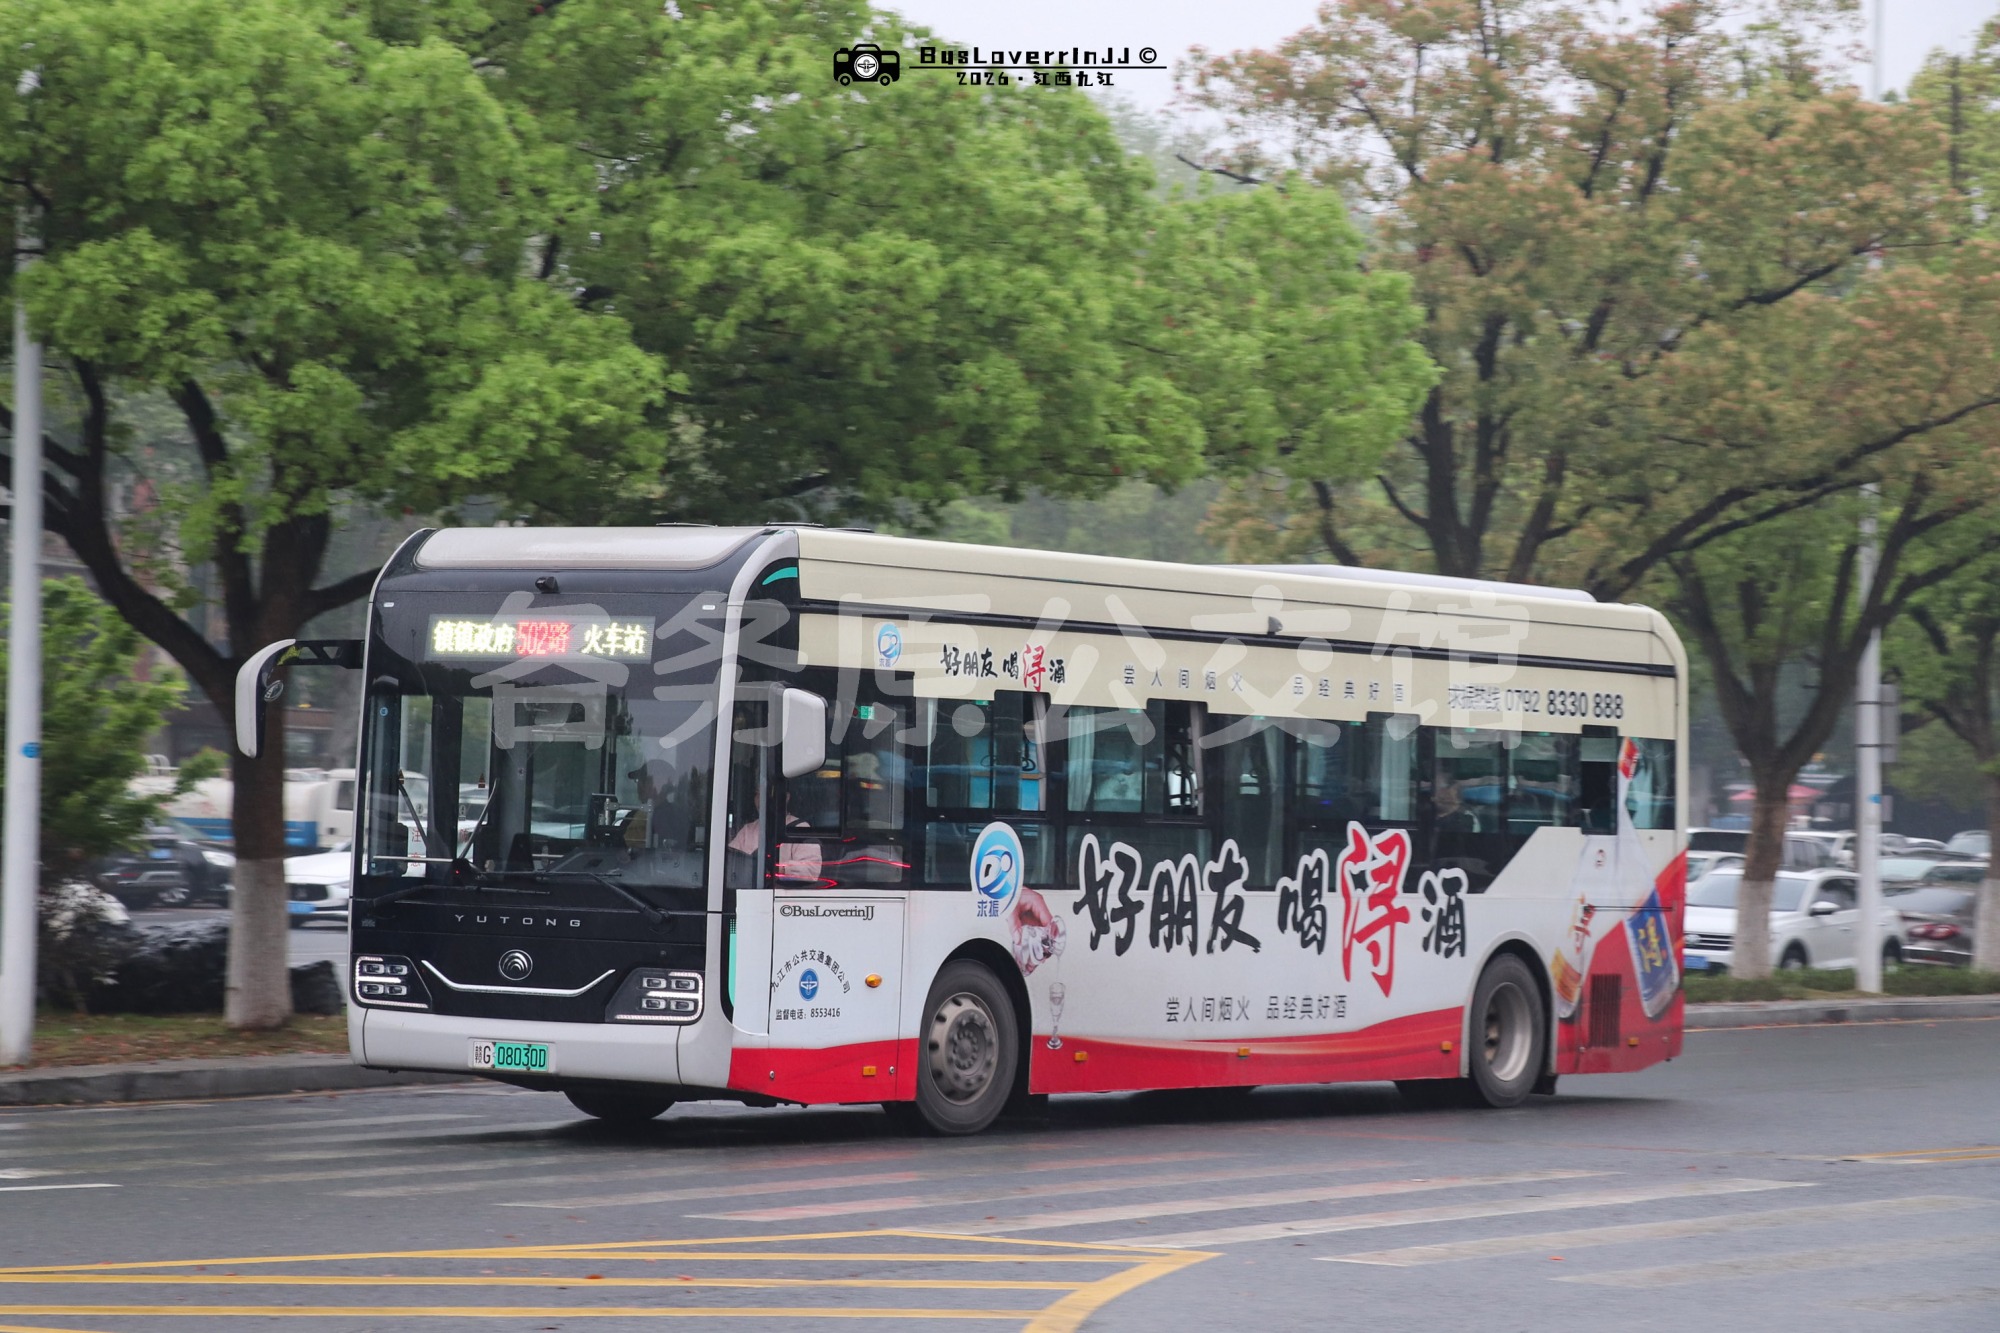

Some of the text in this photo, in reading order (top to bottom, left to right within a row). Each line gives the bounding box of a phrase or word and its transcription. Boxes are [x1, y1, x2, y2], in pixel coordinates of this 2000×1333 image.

[516, 620, 569, 655] 502路
[582, 622, 648, 655] 火车站
[1506, 688, 1540, 713] 0792
[1548, 689, 1588, 717] 8330
[1594, 692, 1624, 719] 888
[455, 914, 581, 928] YUTONG
[771, 949, 850, 994] 九江市公共交通集团公司
[810, 1007, 841, 1018] 8553416
[1166, 994, 1347, 1022] 尝人间烟火 品经典好酒
